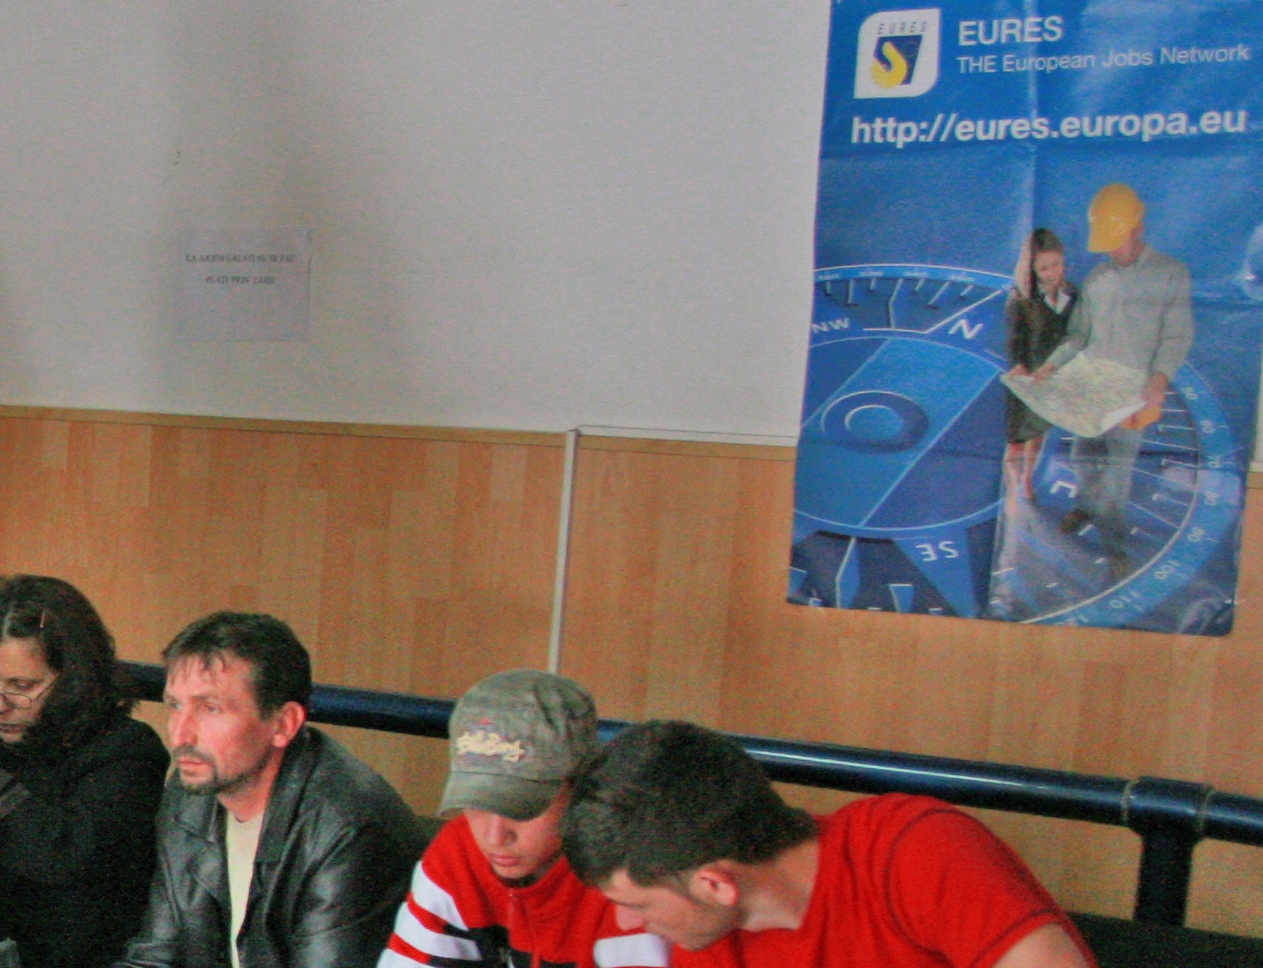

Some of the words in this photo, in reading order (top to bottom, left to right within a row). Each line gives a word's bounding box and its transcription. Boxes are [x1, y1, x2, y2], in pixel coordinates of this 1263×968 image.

[877, 21, 927, 35] EURES
[958, 15, 1064, 46] EURES
[956, 55, 997, 74] THE
[1002, 52, 1096, 75] European
[1102, 49, 1154, 67] Jobs
[1160, 43, 1252, 65] Network
[851, 110, 1249, 149] http://eures.europa.eu
[811, 317, 850, 334] NW
[947, 318, 985, 340] N
